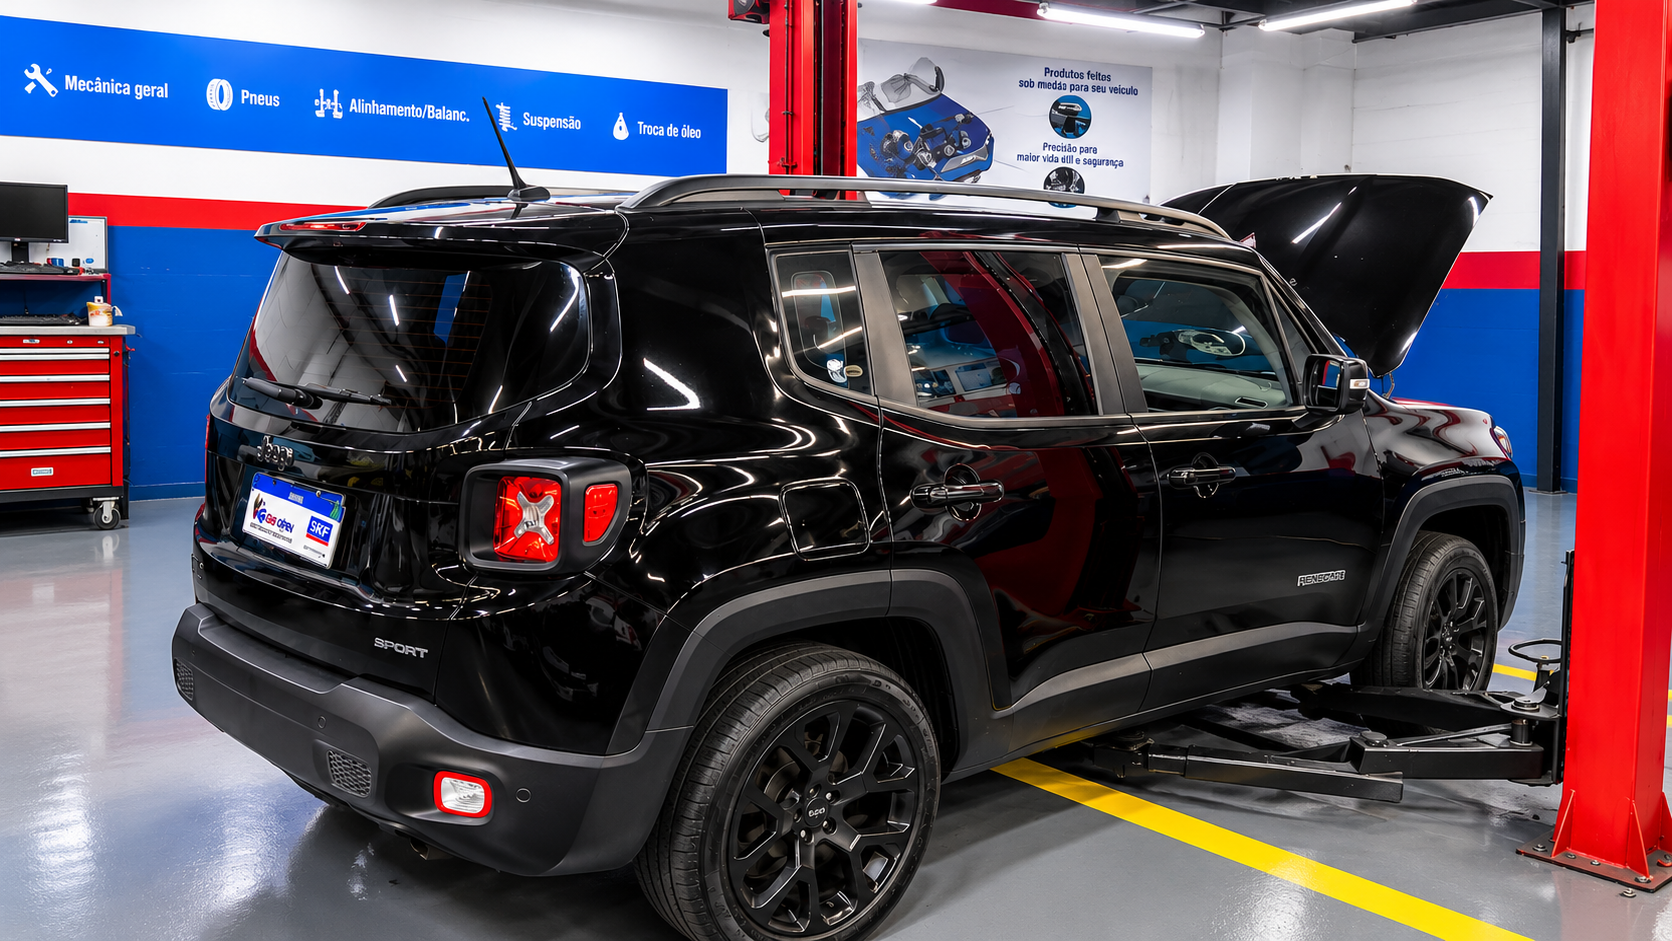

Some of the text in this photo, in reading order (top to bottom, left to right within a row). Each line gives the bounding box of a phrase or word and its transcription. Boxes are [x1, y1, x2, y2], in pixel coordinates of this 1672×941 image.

[1044, 67, 1085, 80] Produtos
[65, 75, 169, 100] Mecânica geral
[1018, 78, 1035, 88] sob
[1069, 83, 1089, 93] para
[1091, 85, 1107, 93] seu
[241, 89, 280, 107] Pneus
[349, 98, 470, 122] Alinhamento/Balanc.
[523, 112, 582, 131] Suspensão
[637, 121, 702, 139] Troca de óleo
[1016, 152, 1041, 162] maior
[1042, 154, 1060, 163] vida
[1075, 157, 1081, 165] e
[309, 520, 331, 538] SKF
[374, 638, 428, 658] SPORT
